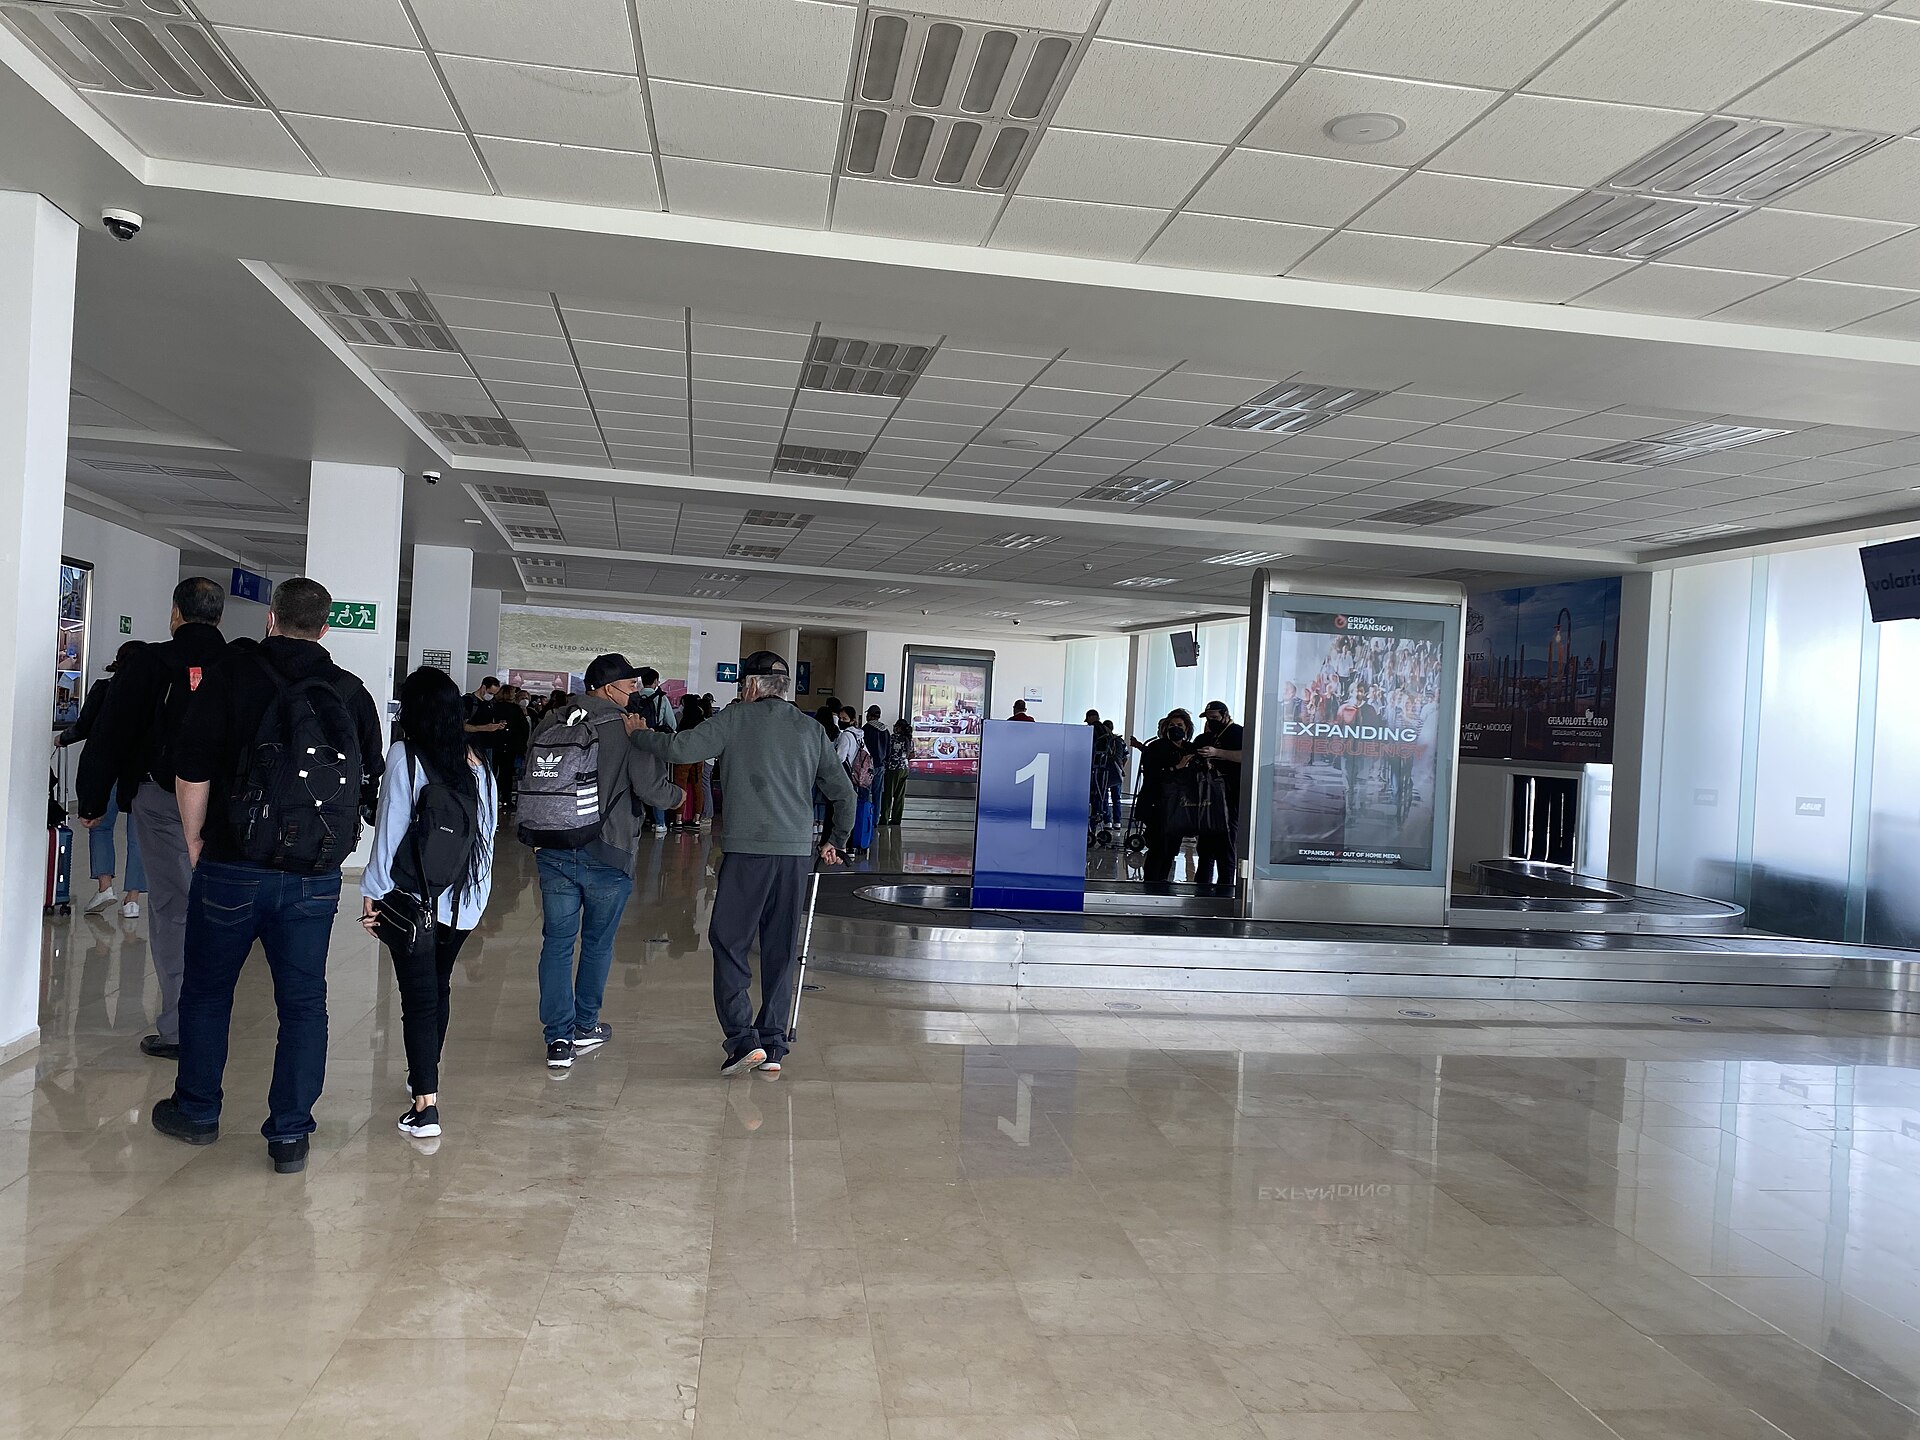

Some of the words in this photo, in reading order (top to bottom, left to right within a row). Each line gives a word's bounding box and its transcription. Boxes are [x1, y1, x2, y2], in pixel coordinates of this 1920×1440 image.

[1347, 616, 1375, 625] GRUPO
[1347, 623, 1394, 632] EXPANSION
[1593, 717, 1609, 727] ORO
[1283, 721, 1418, 742] EXPANDING
[1462, 732, 1481, 741] VIEW
[532, 769, 559, 778] adidas
[1014, 752, 1050, 830] 1
[1298, 849, 1335, 857] EXPANSION
